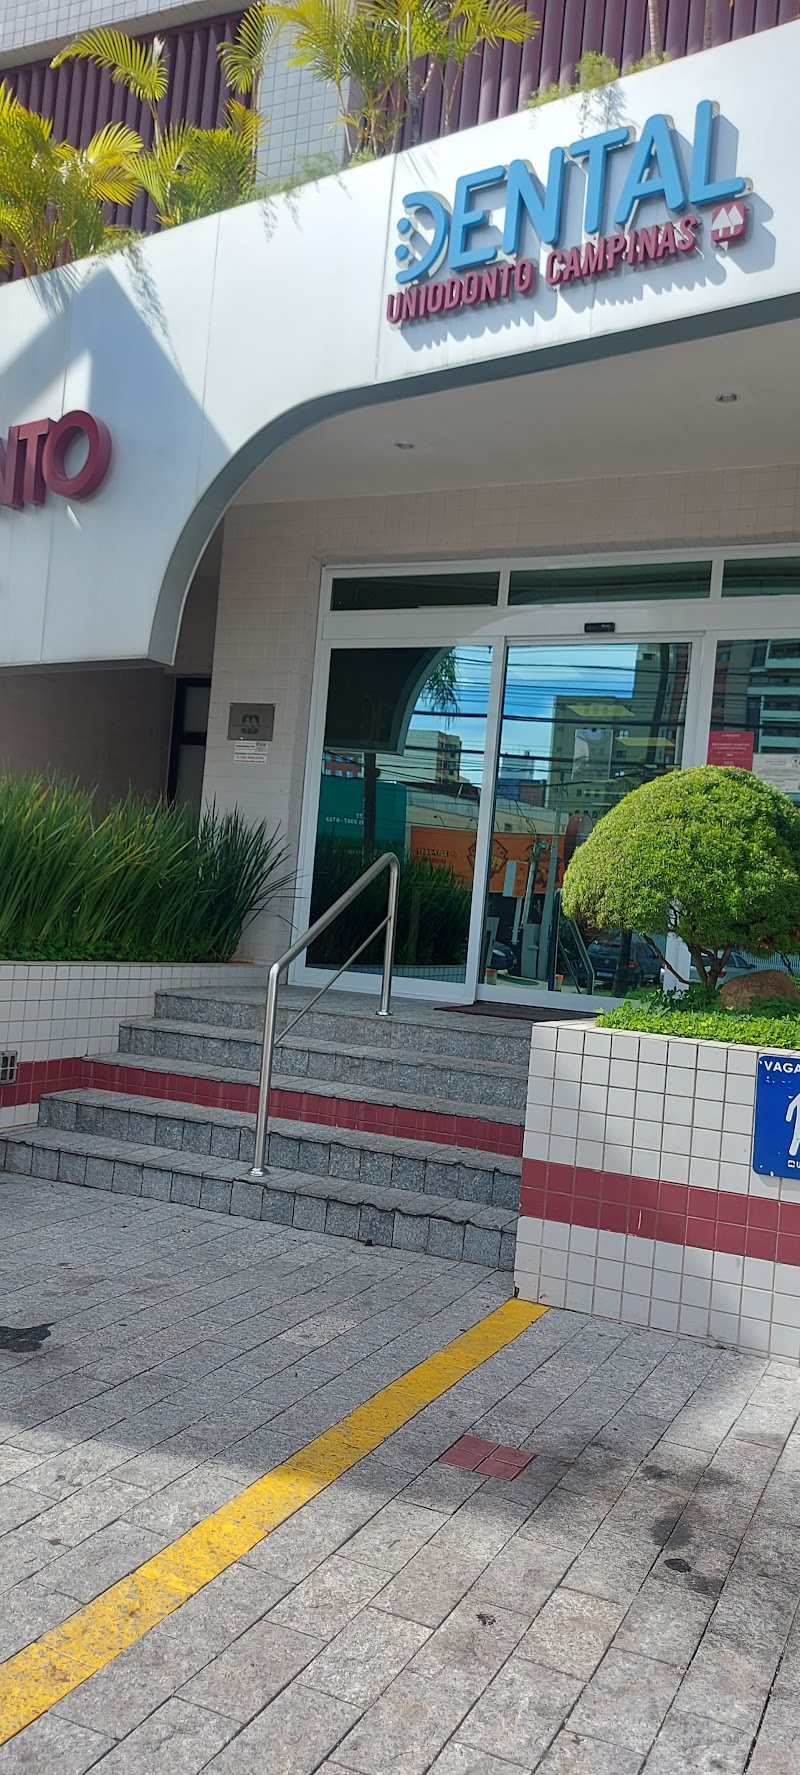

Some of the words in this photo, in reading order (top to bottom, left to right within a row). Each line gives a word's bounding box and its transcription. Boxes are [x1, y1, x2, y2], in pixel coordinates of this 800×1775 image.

[395, 99, 747, 285] DENTAL
[386, 258, 535, 323] UNIODONTO
[546, 214, 699, 286] CAMPINAS
